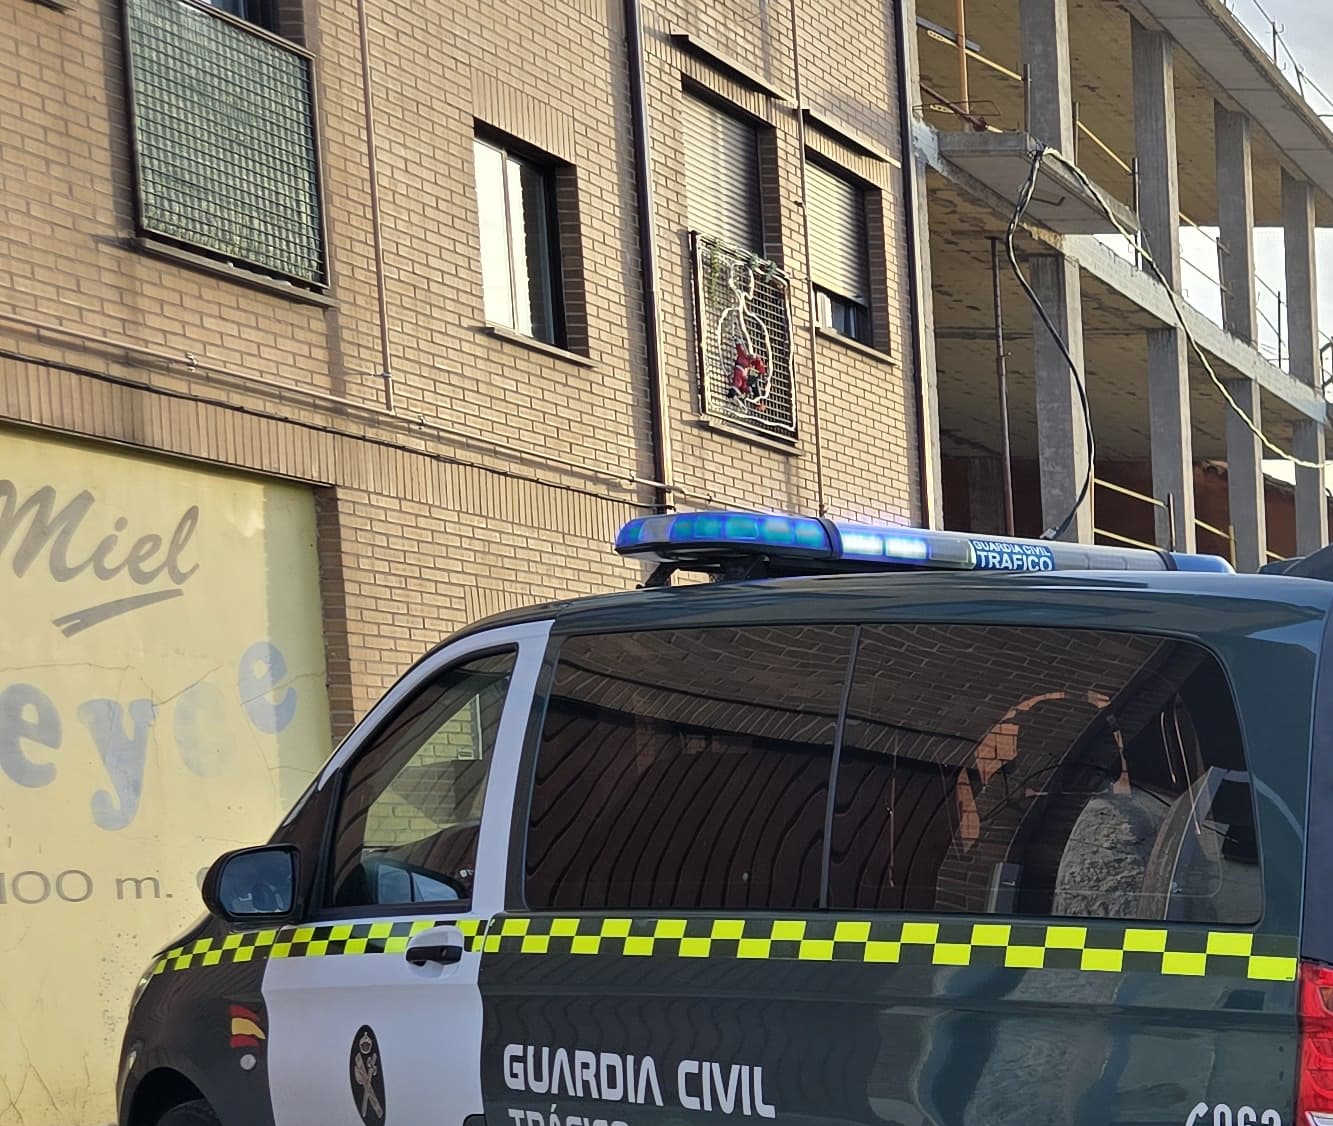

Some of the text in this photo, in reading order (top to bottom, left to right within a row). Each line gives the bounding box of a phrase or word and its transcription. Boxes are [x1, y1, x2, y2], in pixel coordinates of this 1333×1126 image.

[0, 479, 199, 585] Miel
[973, 540, 1051, 557] GUARDIA CIVIL
[115, 876, 173, 900] m.
[503, 1043, 776, 1119] GUARDIA CIVIL
